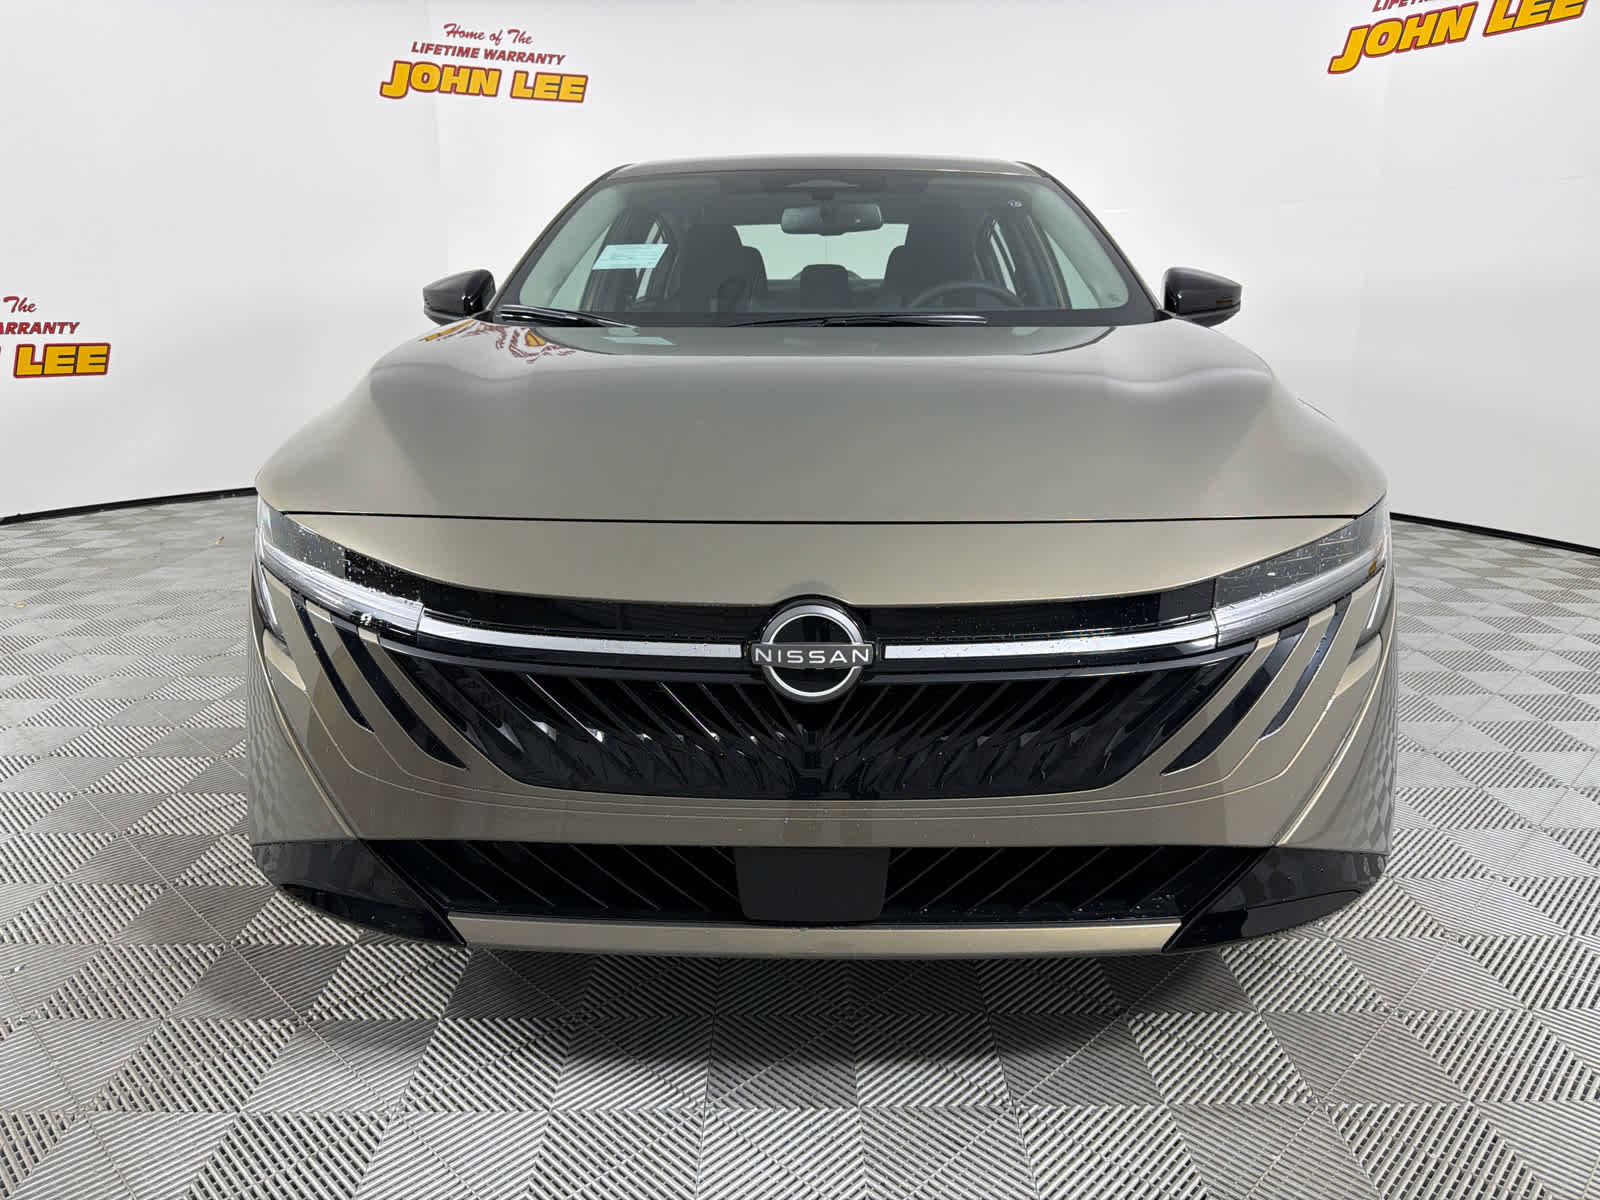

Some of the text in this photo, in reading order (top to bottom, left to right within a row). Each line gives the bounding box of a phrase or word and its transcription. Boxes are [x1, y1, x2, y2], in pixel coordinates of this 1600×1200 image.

[443, 23, 533, 46] Home of The
[1327, 0, 1587, 74] JOHN LEE
[411, 41, 566, 65] LIFETIME WARRANTY
[379, 60, 588, 103] JOHN LEE
[3, 296, 37, 313] The
[13, 342, 111, 378] LEE
[755, 648, 869, 664] NISSAN
